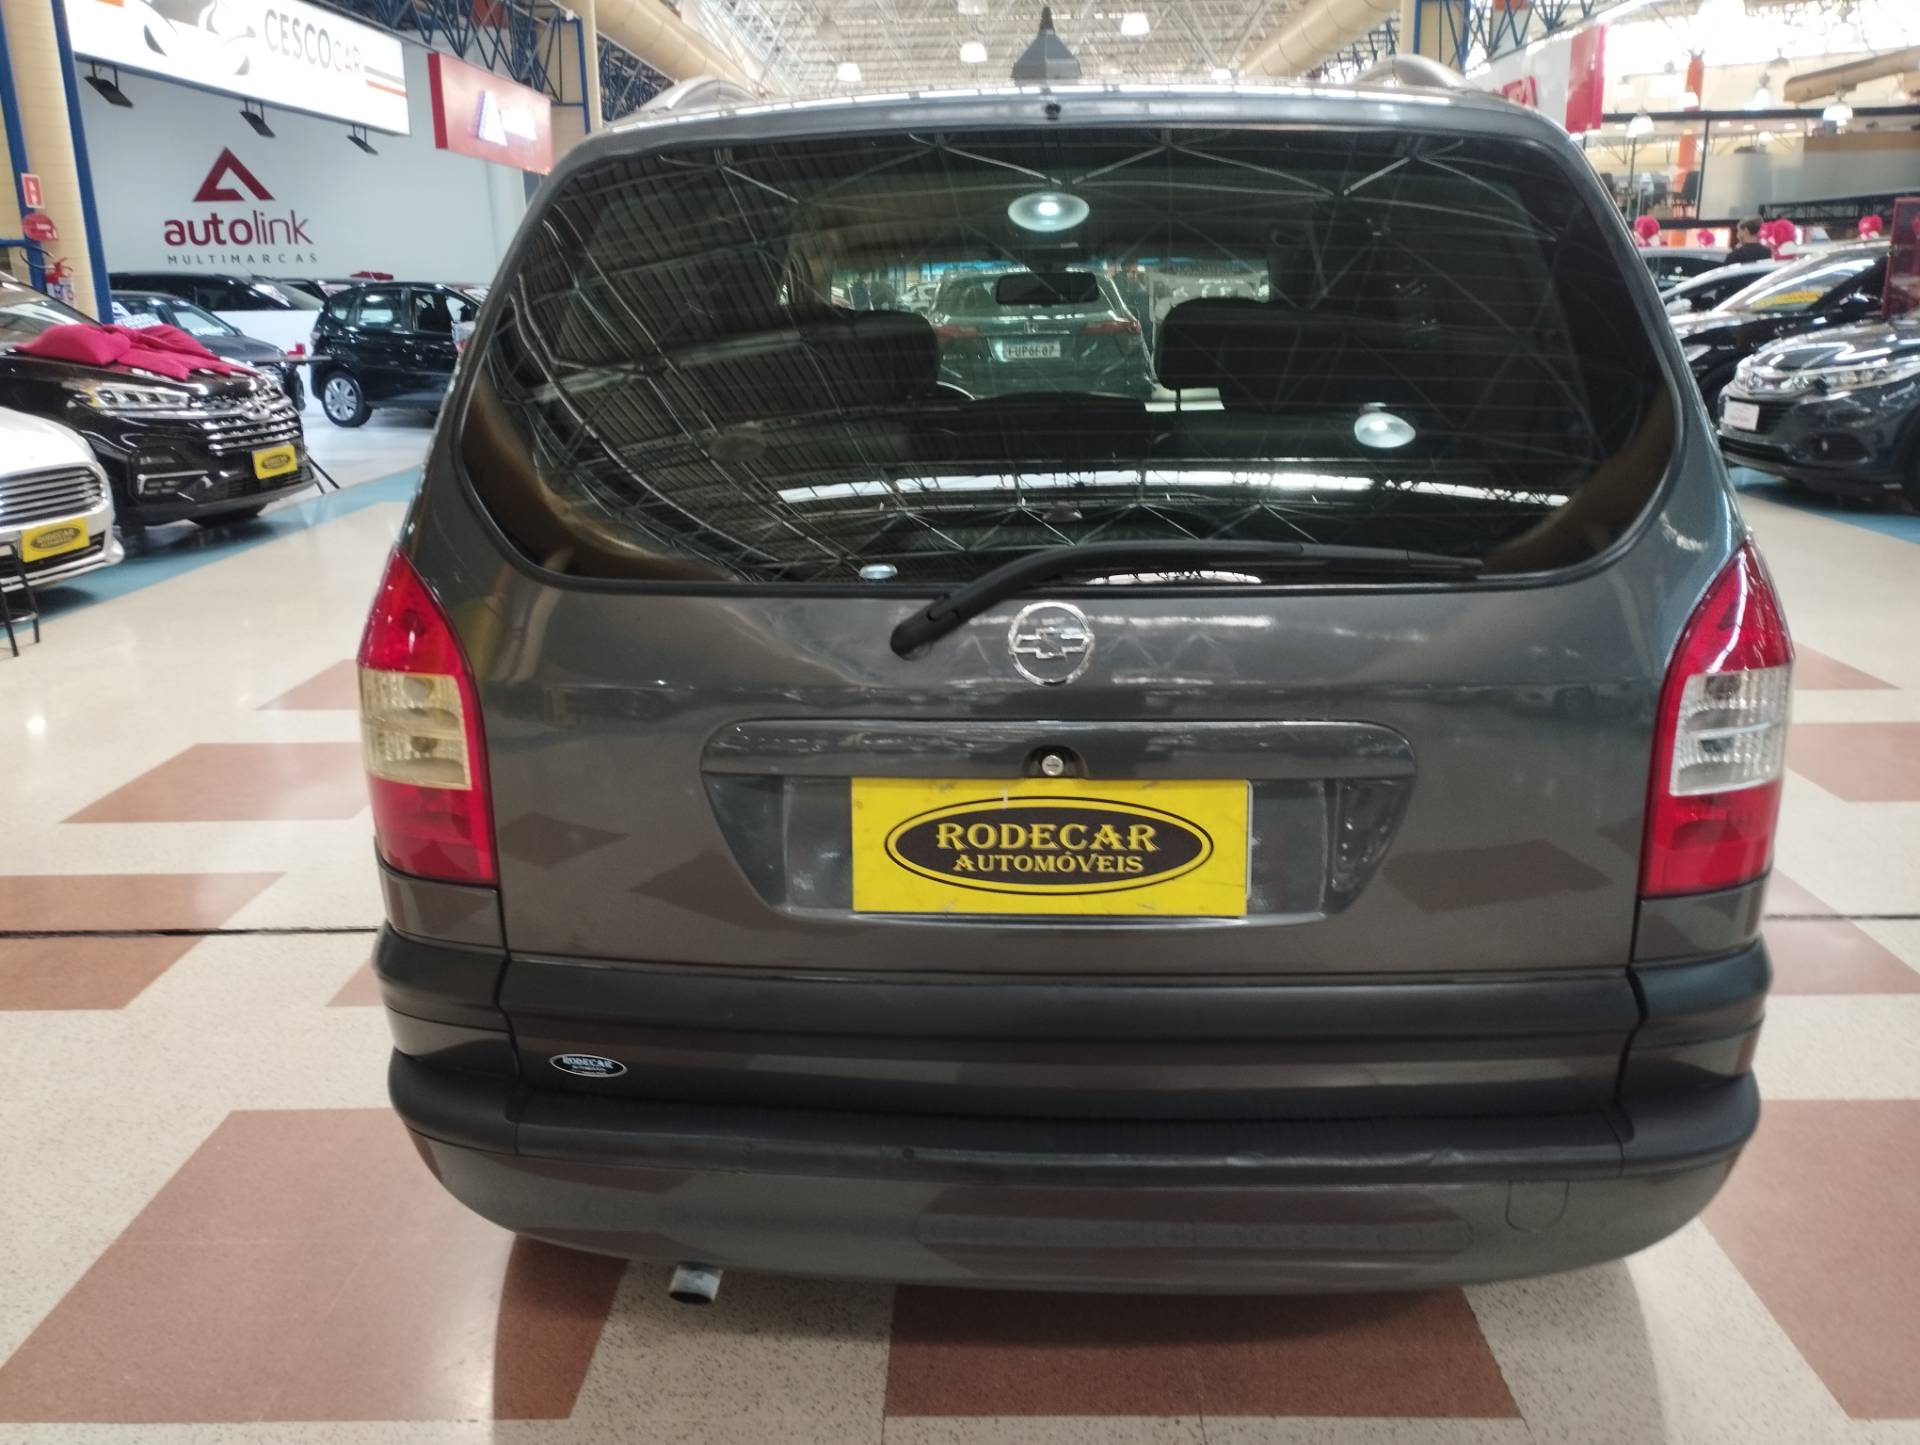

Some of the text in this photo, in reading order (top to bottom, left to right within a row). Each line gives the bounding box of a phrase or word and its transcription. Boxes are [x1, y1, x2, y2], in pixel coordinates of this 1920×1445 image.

[164, 209, 313, 246] autolink
[168, 253, 318, 265] MULTIMARCAS
[936, 822, 1160, 852] RODECAR
[952, 851, 1144, 873] AUTOMÓVEIS
